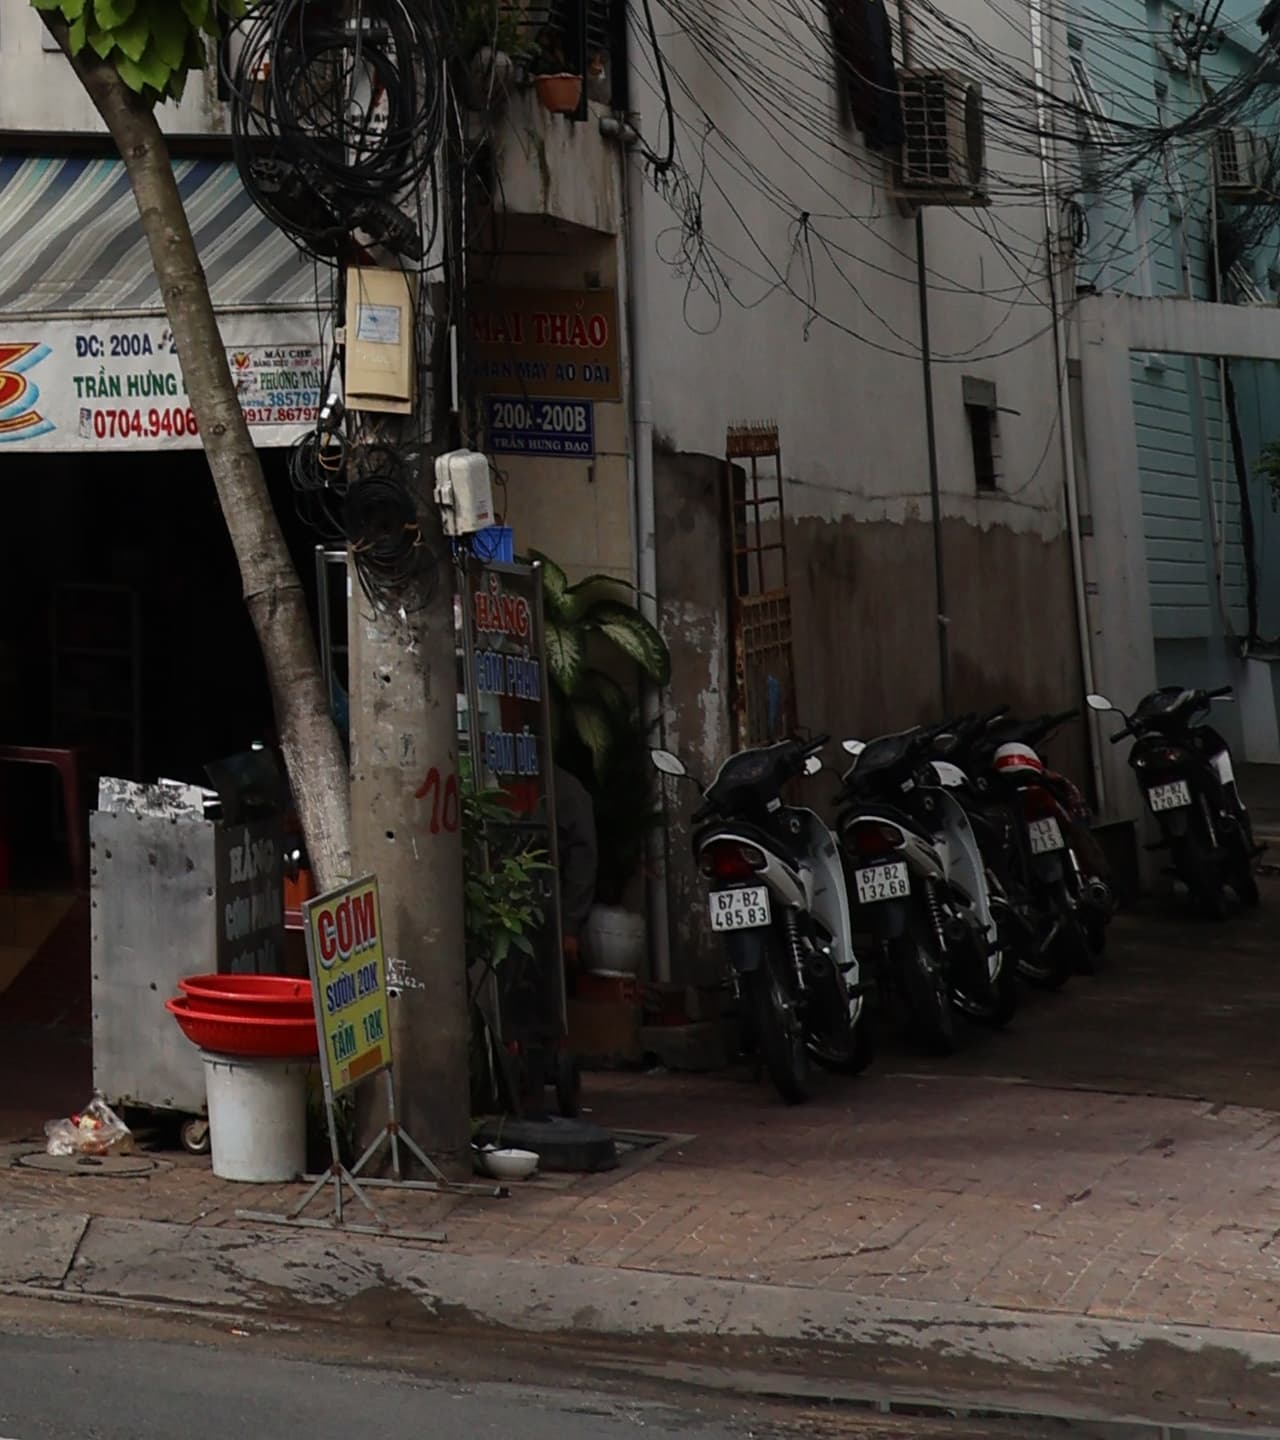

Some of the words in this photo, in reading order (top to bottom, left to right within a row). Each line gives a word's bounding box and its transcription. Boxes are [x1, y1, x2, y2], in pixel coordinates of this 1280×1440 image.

[533, 296, 608, 347] THẢO
[75, 335, 105, 358] ĐC:
[111, 333, 153, 357] 200A
[73, 364, 122, 398] TRẦN
[127, 370, 178, 398] HƯNG
[493, 402, 588, 433] 200A-200B
[415, 767, 459, 834] 10
[862, 866, 900, 885] 67-B2
[715, 907, 767, 928] 485.83
[718, 891, 760, 911] 67-B2
[318, 891, 376, 961] CƠM
[358, 962, 379, 996] 20K
[363, 1008, 384, 1043] 18K
